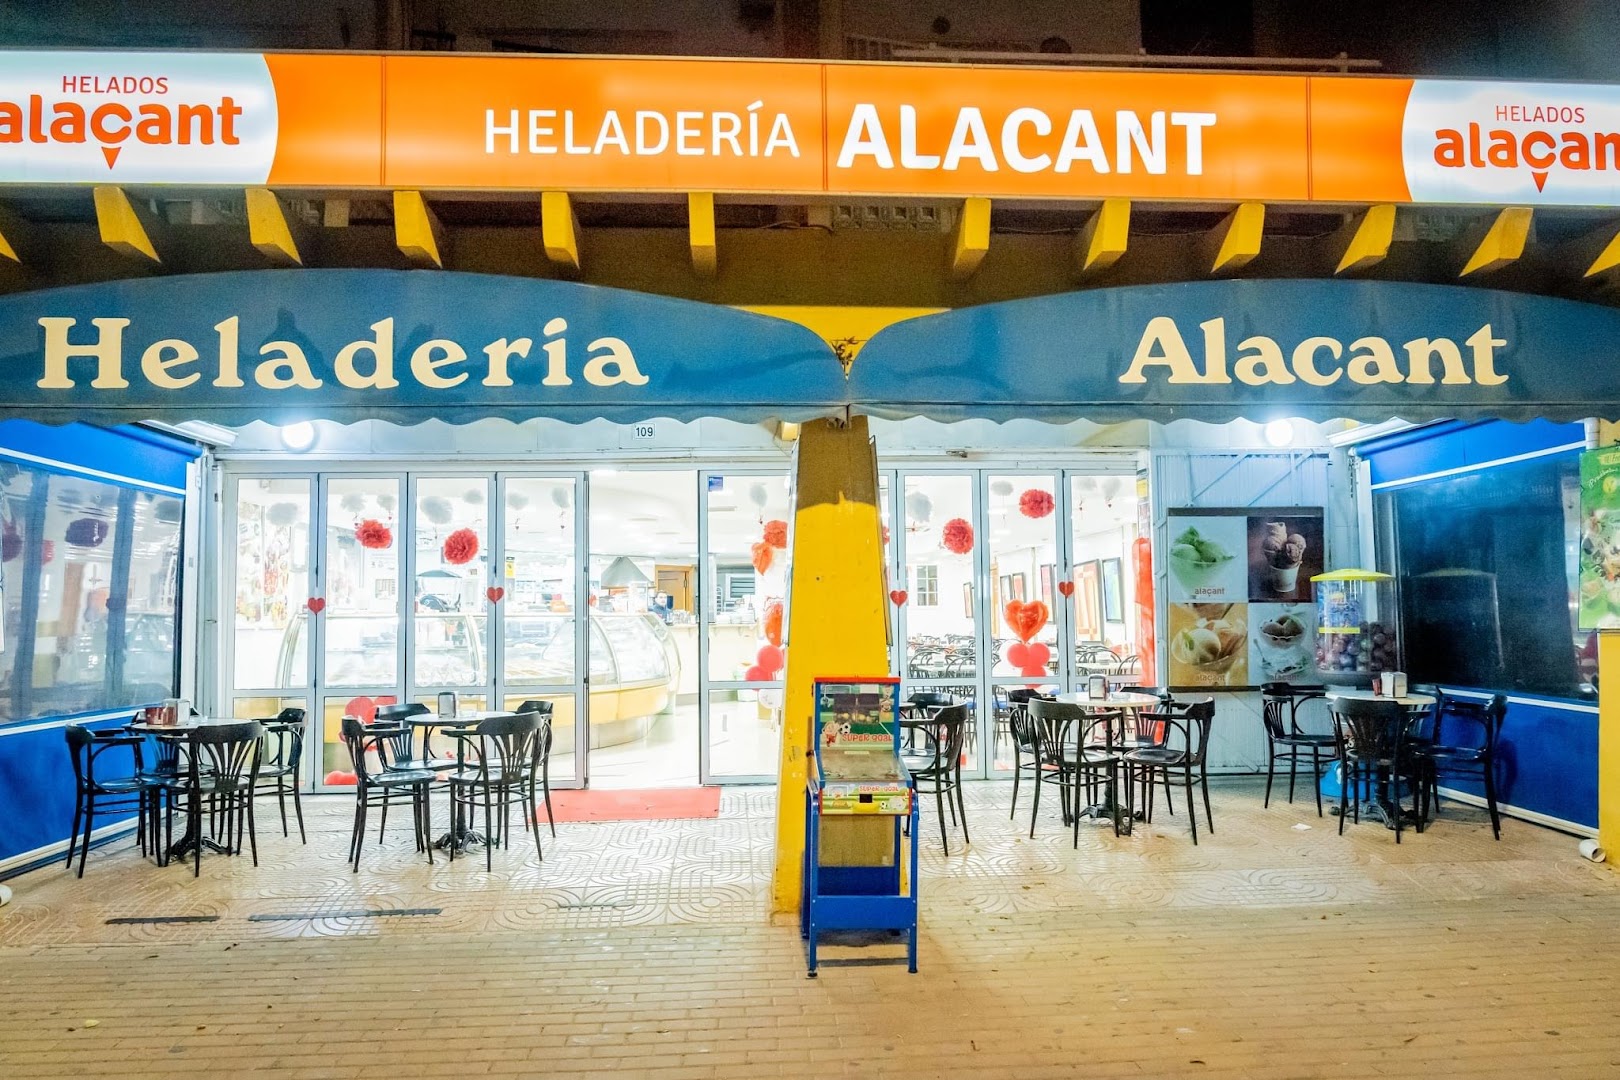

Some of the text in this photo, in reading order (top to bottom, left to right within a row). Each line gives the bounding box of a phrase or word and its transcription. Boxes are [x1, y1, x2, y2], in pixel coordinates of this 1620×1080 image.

[62, 75, 169, 95] HELADOS
[1496, 105, 1585, 123] HELADOS
[484, 100, 1217, 176] HELADERÍA ALACANT
[36, 315, 1510, 391] Heladeria Alacant
[636, 426, 654, 436] 109
[1194, 587, 1225, 598] alaçant
